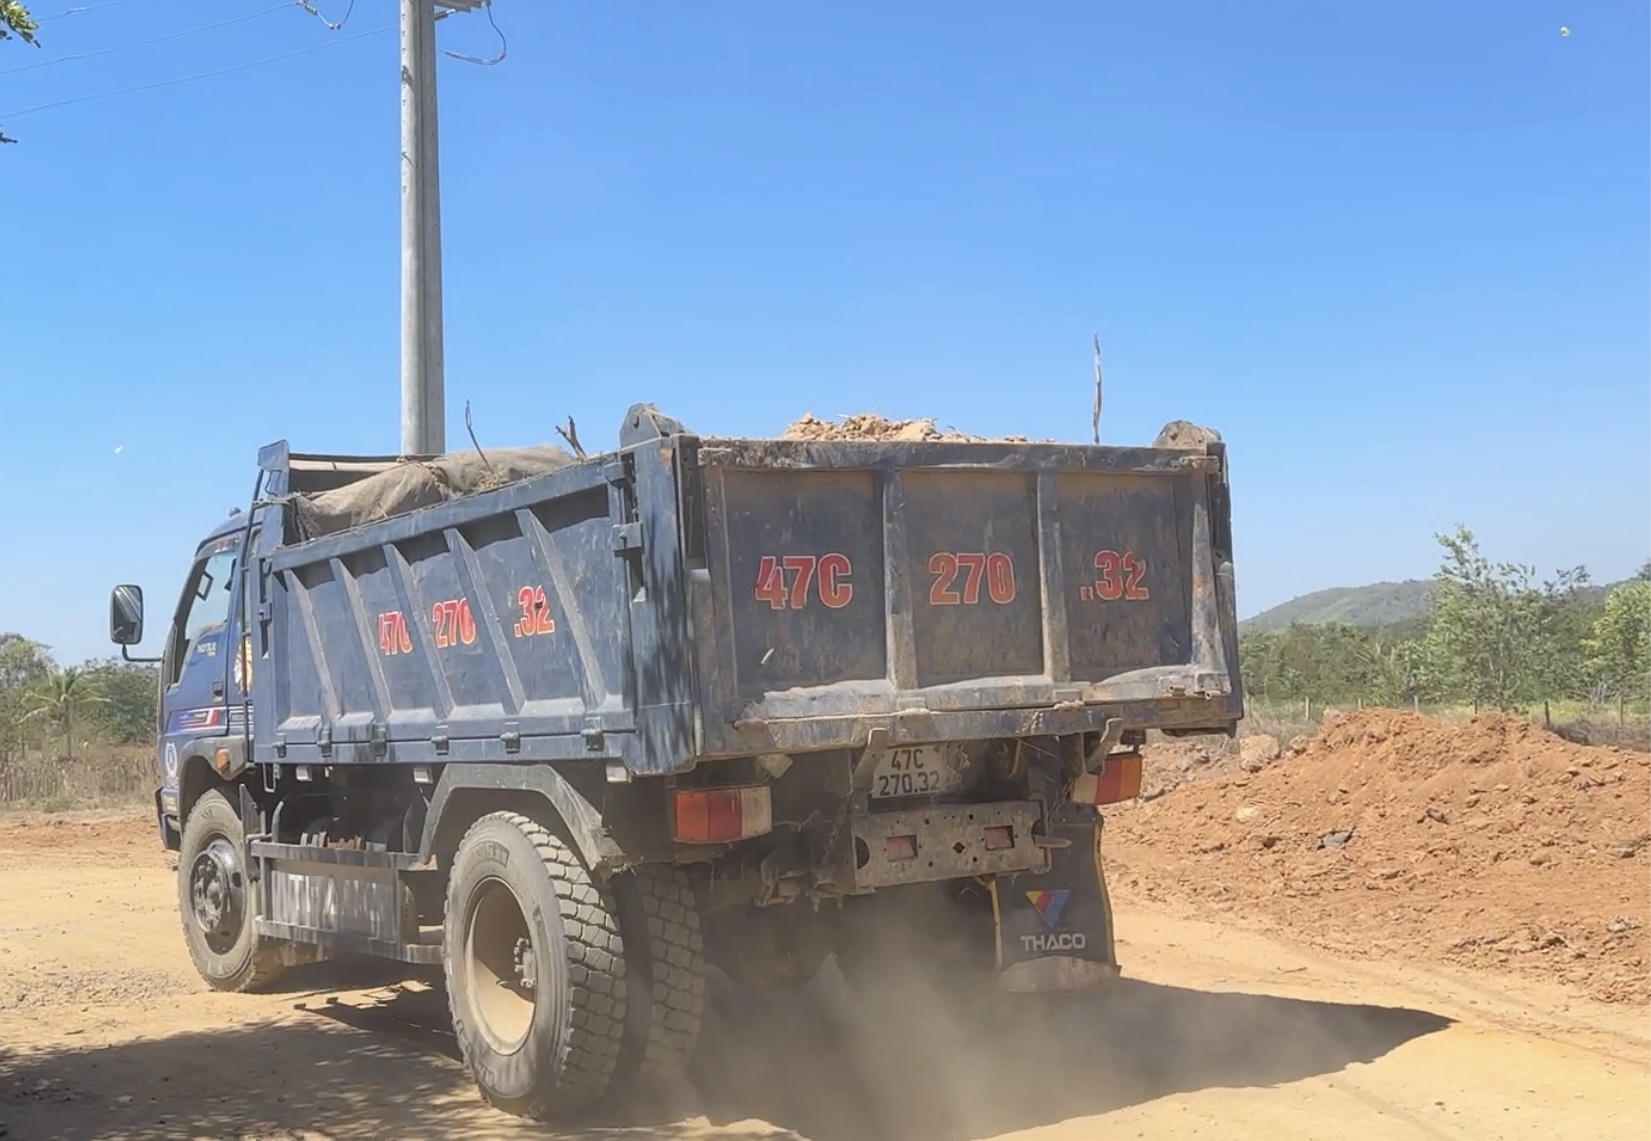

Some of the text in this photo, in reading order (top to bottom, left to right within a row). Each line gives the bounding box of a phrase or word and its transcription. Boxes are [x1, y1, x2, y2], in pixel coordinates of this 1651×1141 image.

[755, 552, 853, 609] 47C
[929, 552, 1015, 605] 270
[513, 585, 555, 638] .32
[891, 748, 924, 770] 47C
[878, 770, 940, 796] 270.32
[1020, 932, 1086, 952] THACO
